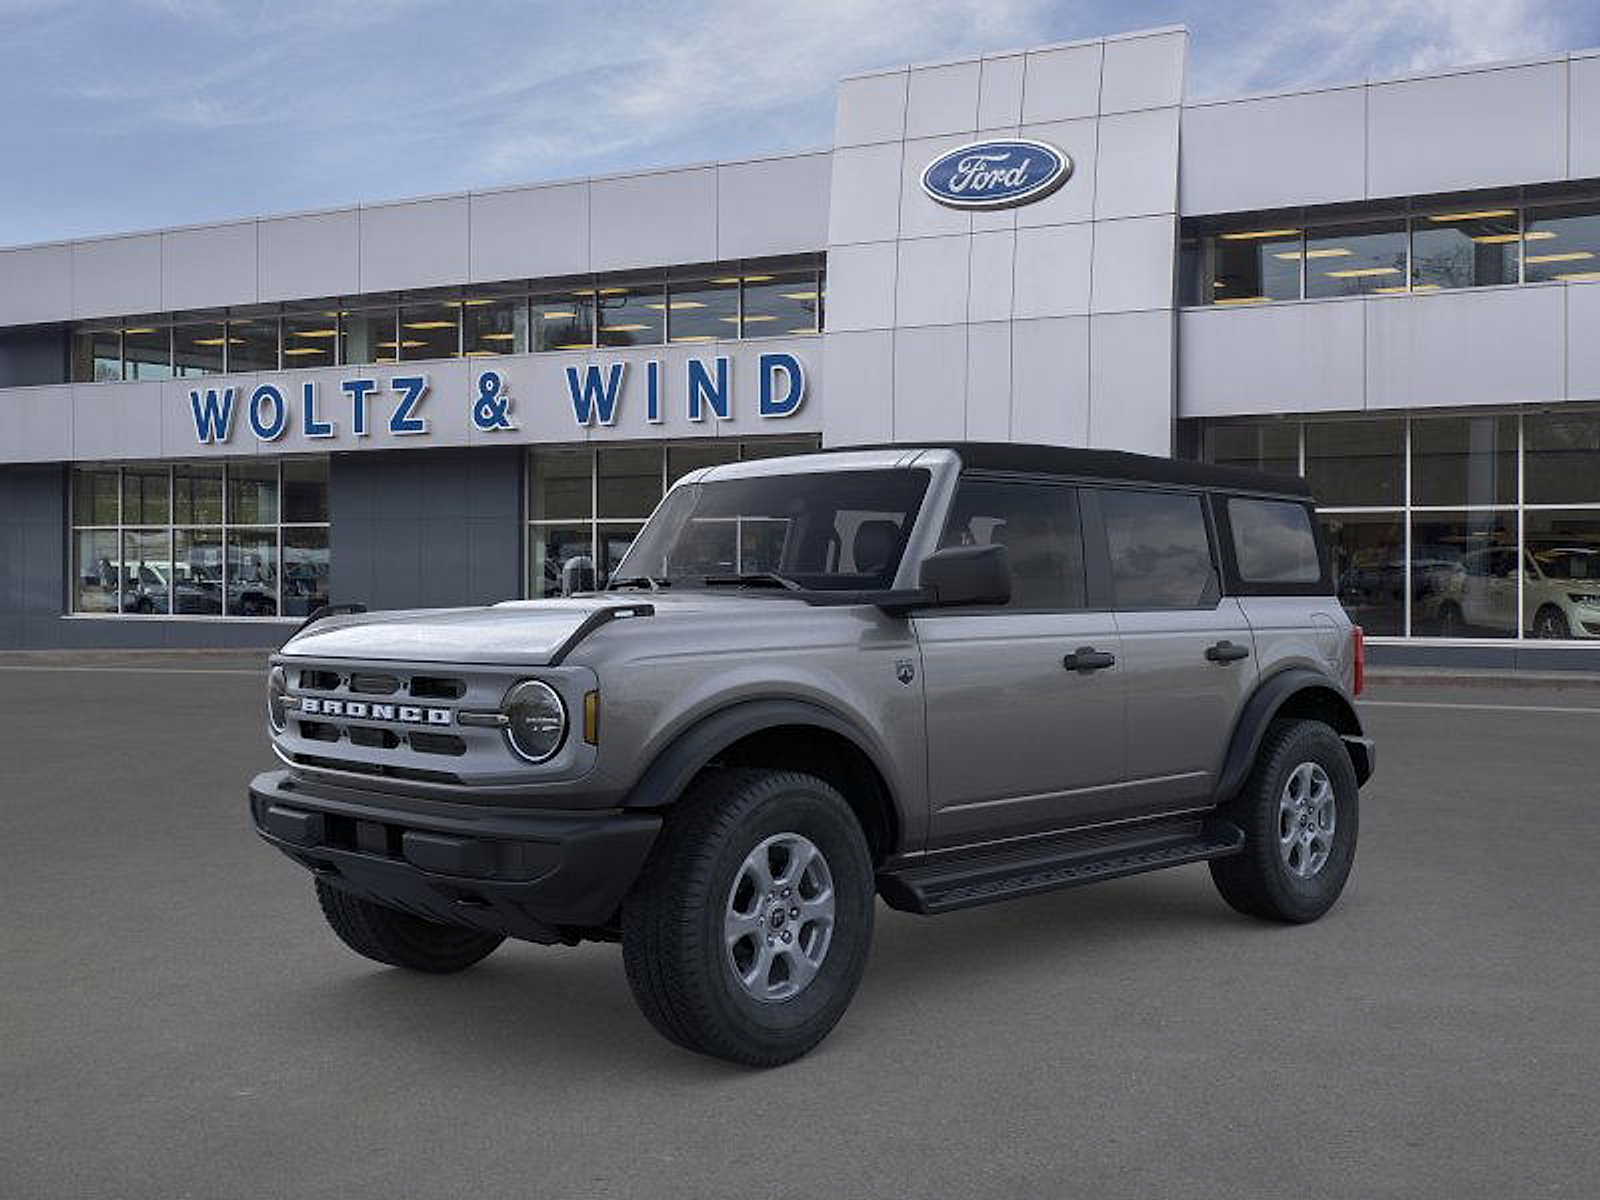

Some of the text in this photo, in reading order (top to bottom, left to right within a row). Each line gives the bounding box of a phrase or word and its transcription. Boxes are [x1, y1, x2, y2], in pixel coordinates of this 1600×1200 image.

[950, 152, 1031, 193] Ford
[190, 353, 805, 443] WOLTZ & WIND
[302, 698, 451, 725] BRONCO
